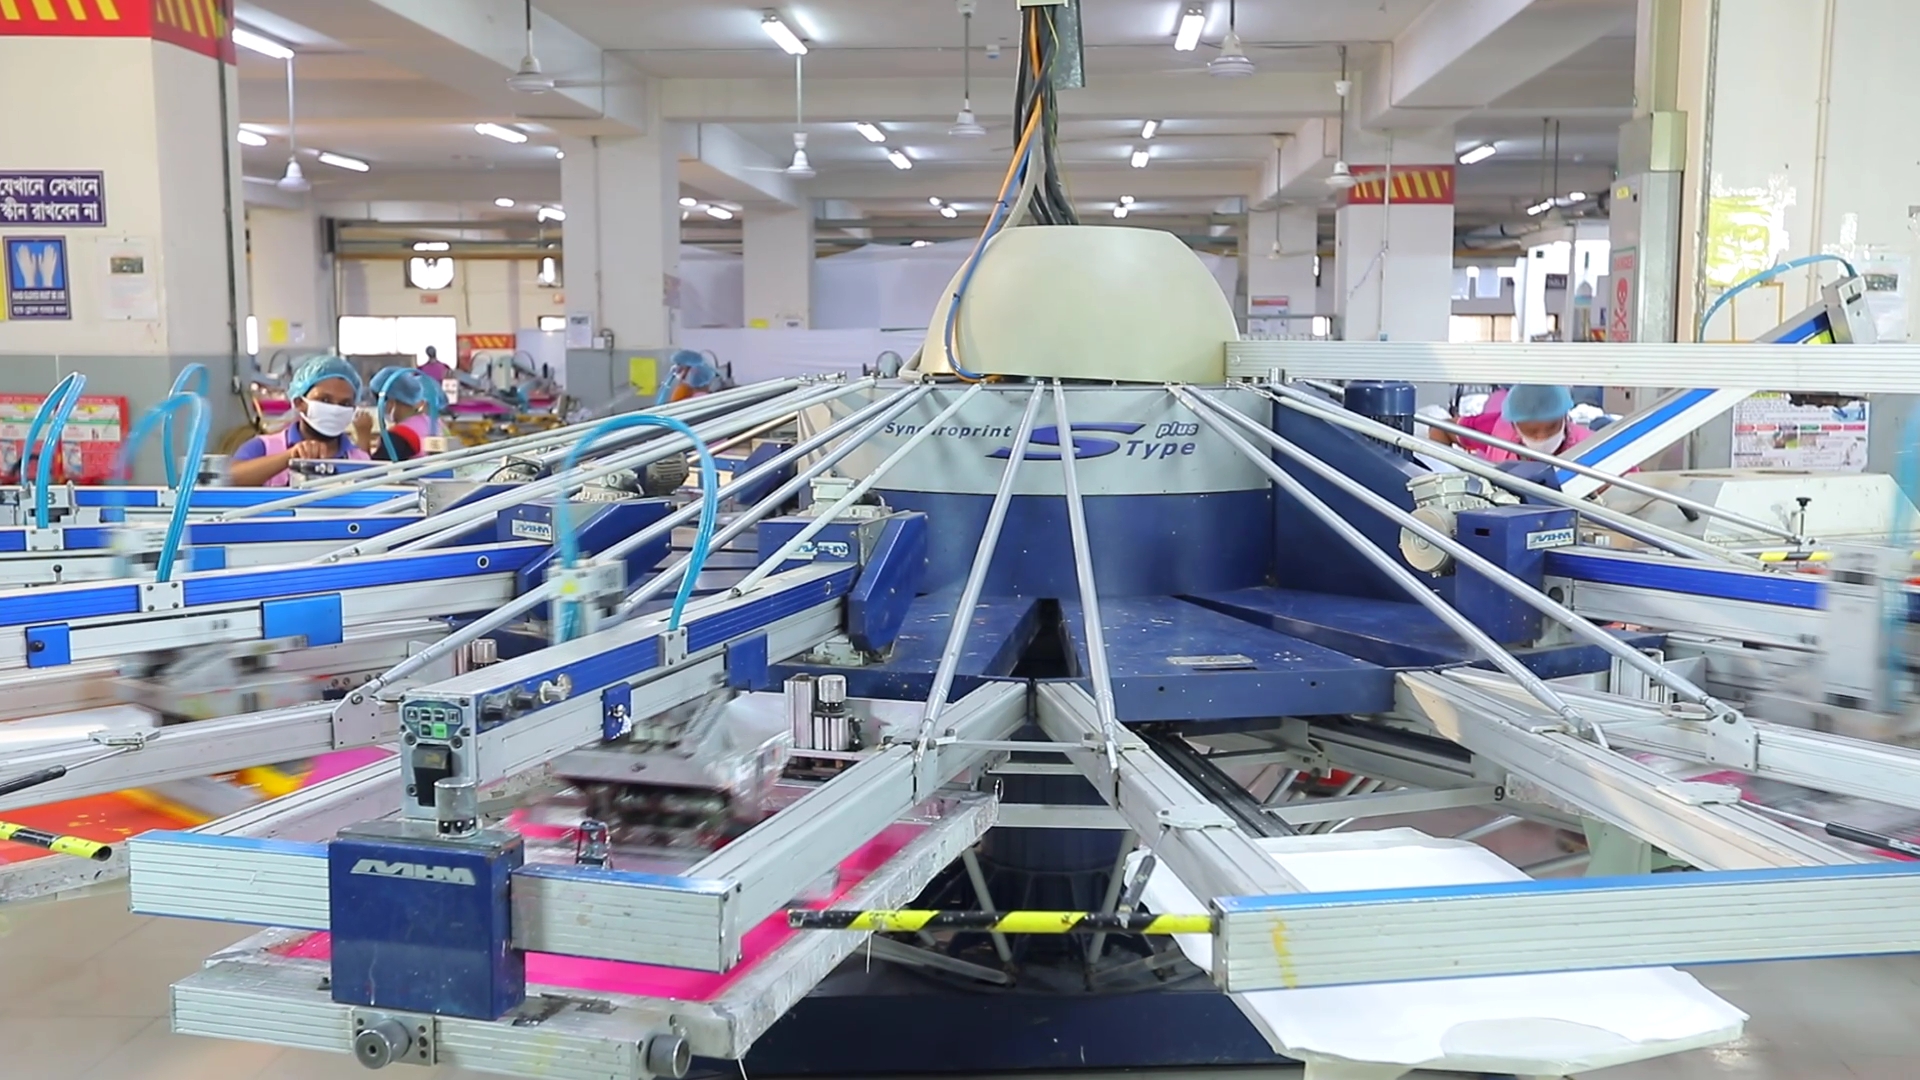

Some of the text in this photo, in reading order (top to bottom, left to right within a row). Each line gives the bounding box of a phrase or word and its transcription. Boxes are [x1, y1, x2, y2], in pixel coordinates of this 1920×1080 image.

[49, 176, 98, 196] সেখানে
[30, 201, 79, 221] রাখবেন
[81, 201, 98, 220] না
[1155, 421, 1199, 439] plus
[1125, 440, 1196, 460] Type
[1494, 785, 1505, 801] 9
[350, 858, 476, 886] MHM
